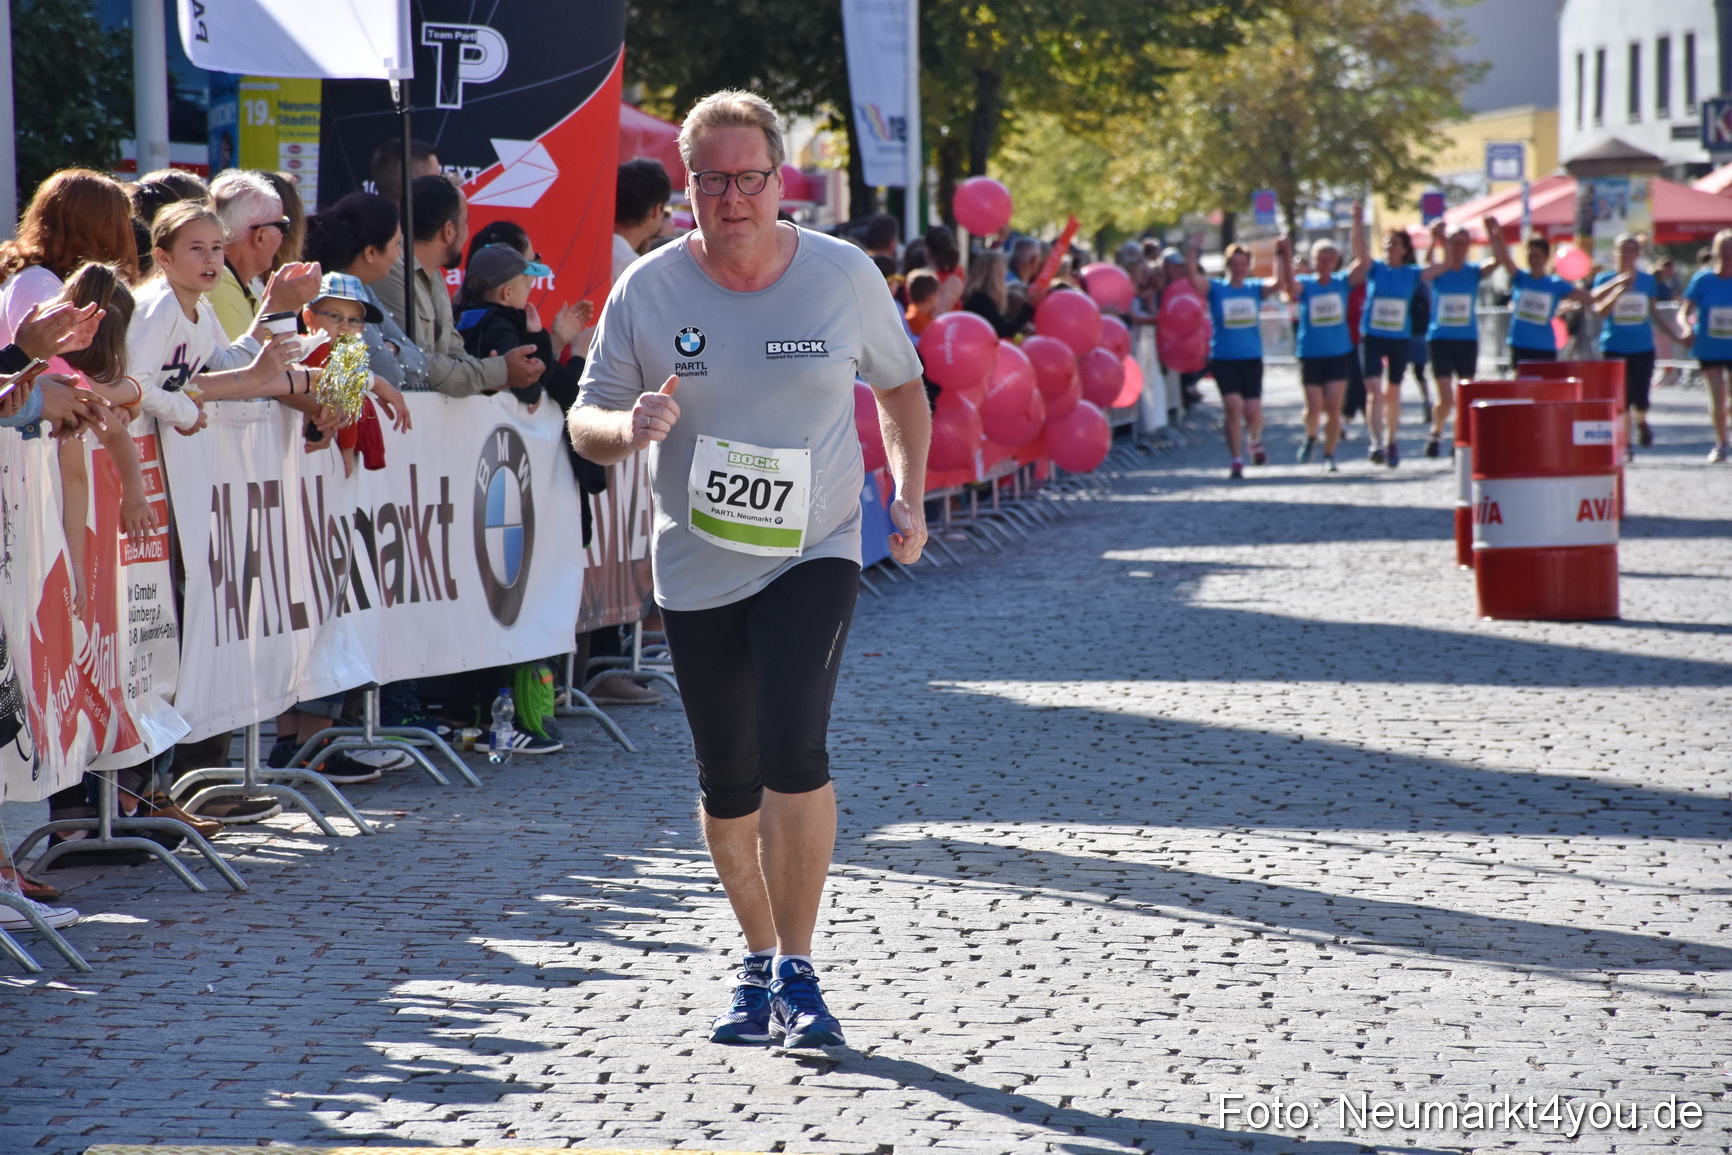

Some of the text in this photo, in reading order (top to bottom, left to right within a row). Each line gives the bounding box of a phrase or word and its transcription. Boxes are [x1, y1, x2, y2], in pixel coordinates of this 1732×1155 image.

[428, 29, 478, 41] Team Partl
[245, 99, 275, 126] 19.
[767, 340, 826, 354] BOCK
[675, 361, 708, 371] PARTL
[675, 370, 708, 378] Neumarkt
[728, 451, 780, 470] BOCK
[705, 470, 794, 512] 5207
[711, 507, 772, 524] PARTL Neumarkt
[301, 463, 459, 626] Neumarkt
[208, 475, 310, 647] PARTL
[134, 583, 157, 601] GmbH
